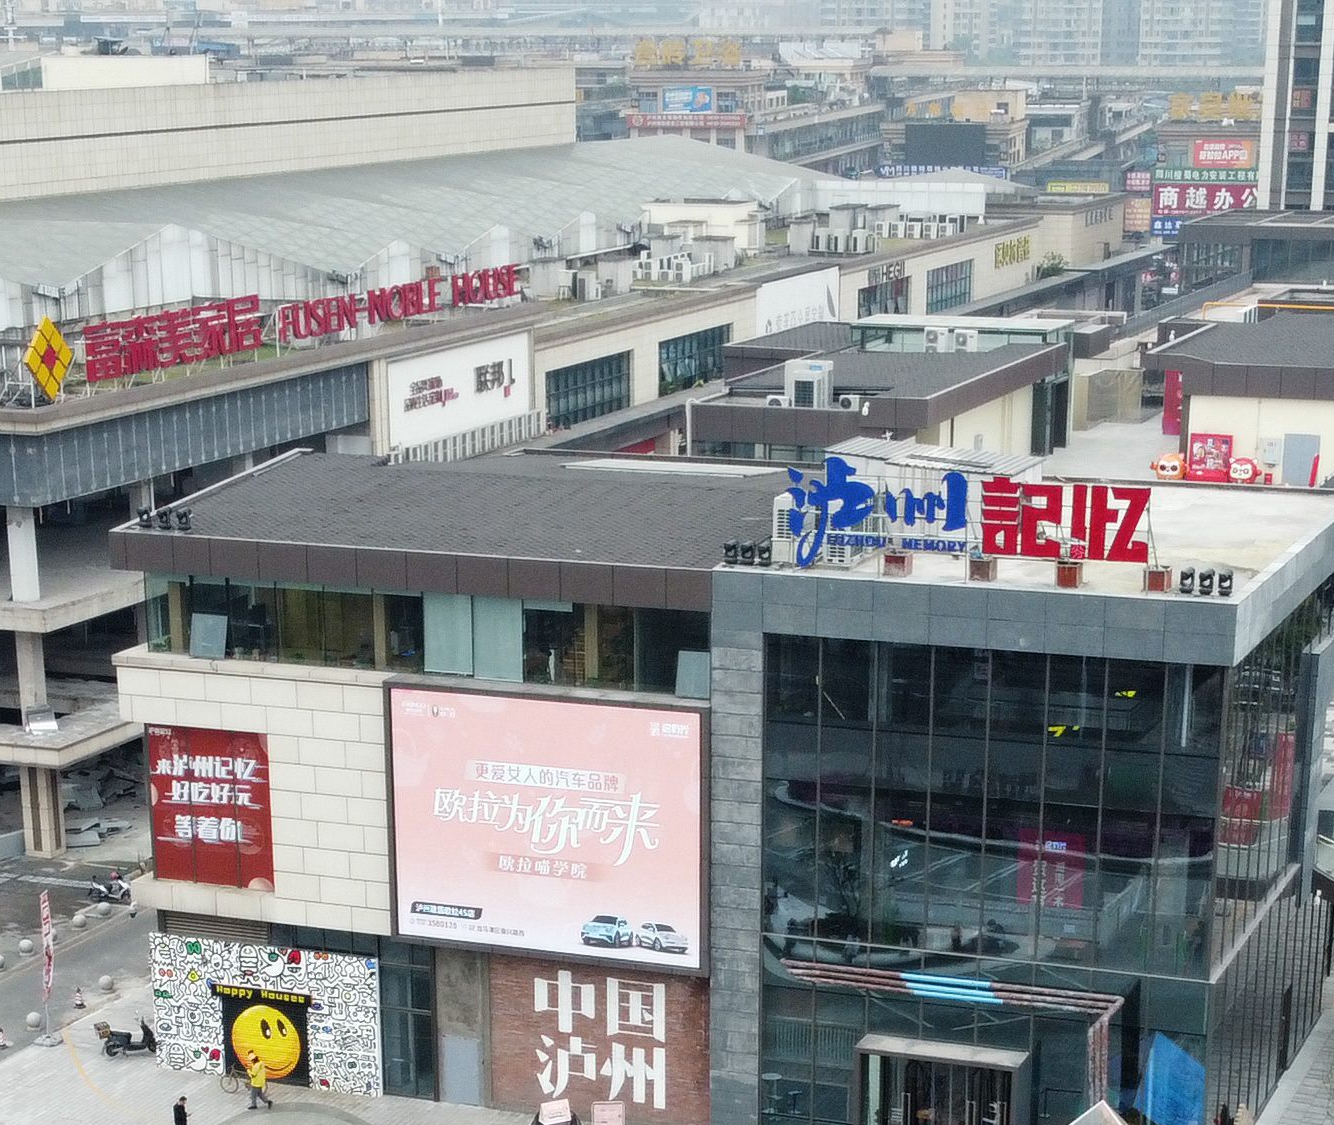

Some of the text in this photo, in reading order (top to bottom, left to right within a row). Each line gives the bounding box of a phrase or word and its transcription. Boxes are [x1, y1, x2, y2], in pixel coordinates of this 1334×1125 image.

[83, 294, 263, 383] 富森美家居
[451, 264, 522, 307] HOUSE
[902, 537, 967, 552] MEMORY
[156, 755, 257, 780] 来泸州记忆
[474, 762, 620, 792] 更爱女人的汽车品牌
[171, 780, 252, 806] 好吃好玩
[174, 814, 243, 842] 等着你
[433, 787, 660, 867] 欧拉为你而来
[498, 855, 588, 880] 欧拉喵学院
[217, 985, 254, 999] Happy
[534, 969, 666, 1042] 中国
[535, 1035, 667, 1110] 泸州
